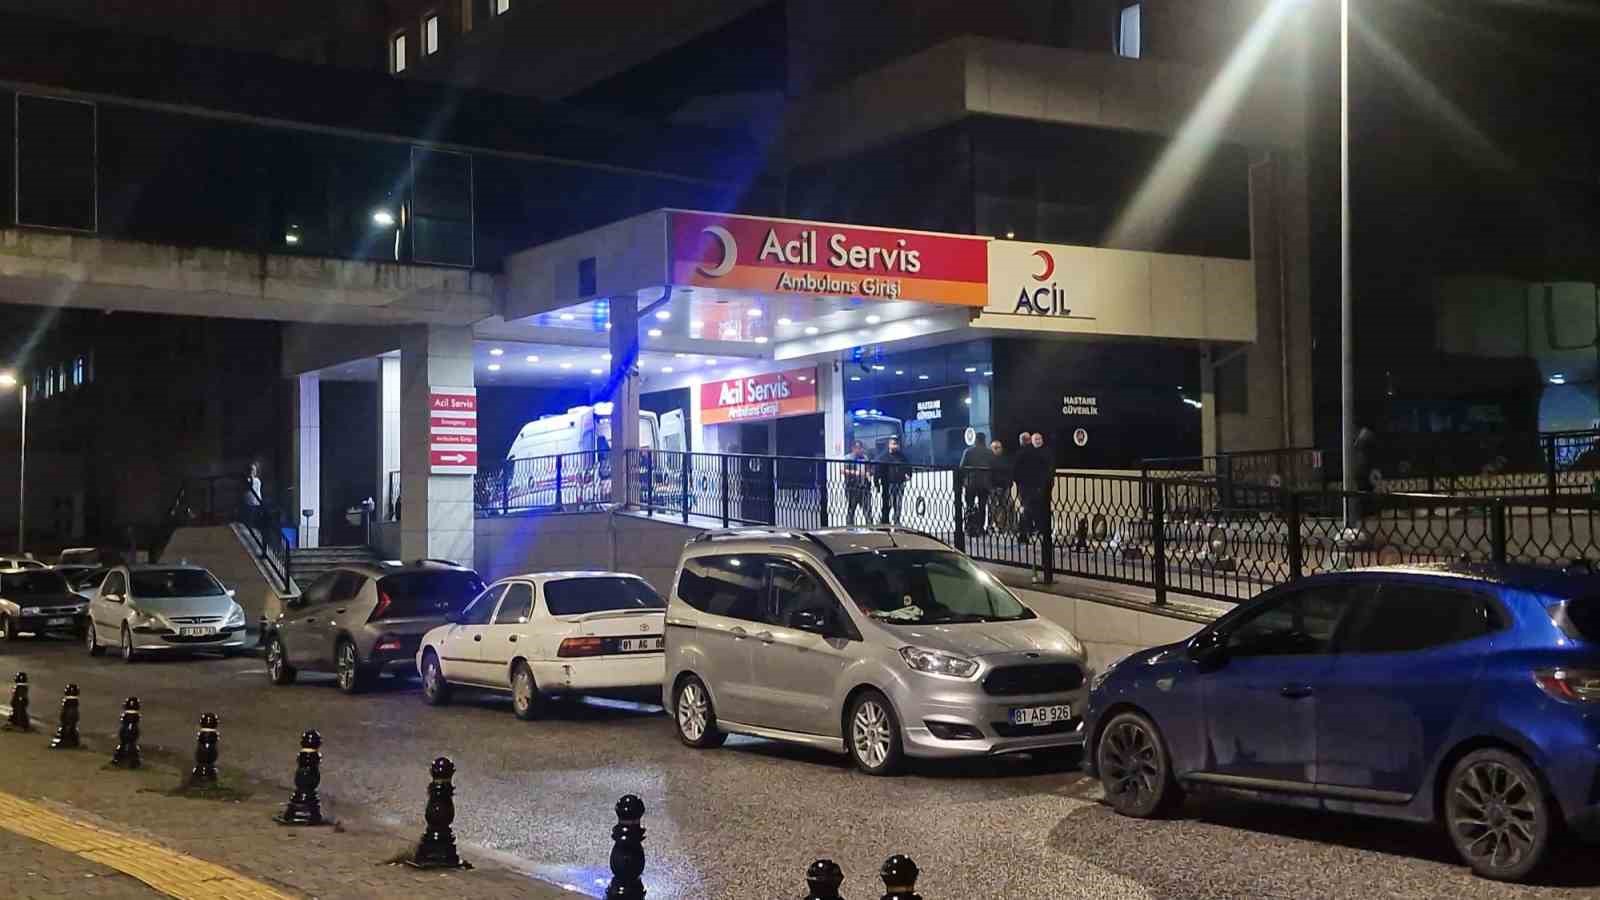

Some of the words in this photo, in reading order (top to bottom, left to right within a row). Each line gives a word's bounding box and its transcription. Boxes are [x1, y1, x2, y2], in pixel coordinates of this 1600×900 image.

[760, 229, 817, 264] Acil
[830, 234, 921, 272] Servis
[777, 271, 857, 293] Ambulans
[862, 274, 902, 298] Girişi
[1016, 283, 1070, 316] ACİL
[719, 380, 743, 405] Acil
[748, 376, 790, 402] Servis
[1063, 396, 1097, 406] HASTANE
[434, 398, 449, 408] Acil
[451, 399, 474, 409] Servis
[1062, 405, 1098, 415] GÜVENLİK
[1016, 710, 1027, 722] 81
[1032, 708, 1047, 721] AB
[1050, 706, 1069, 720] 926
